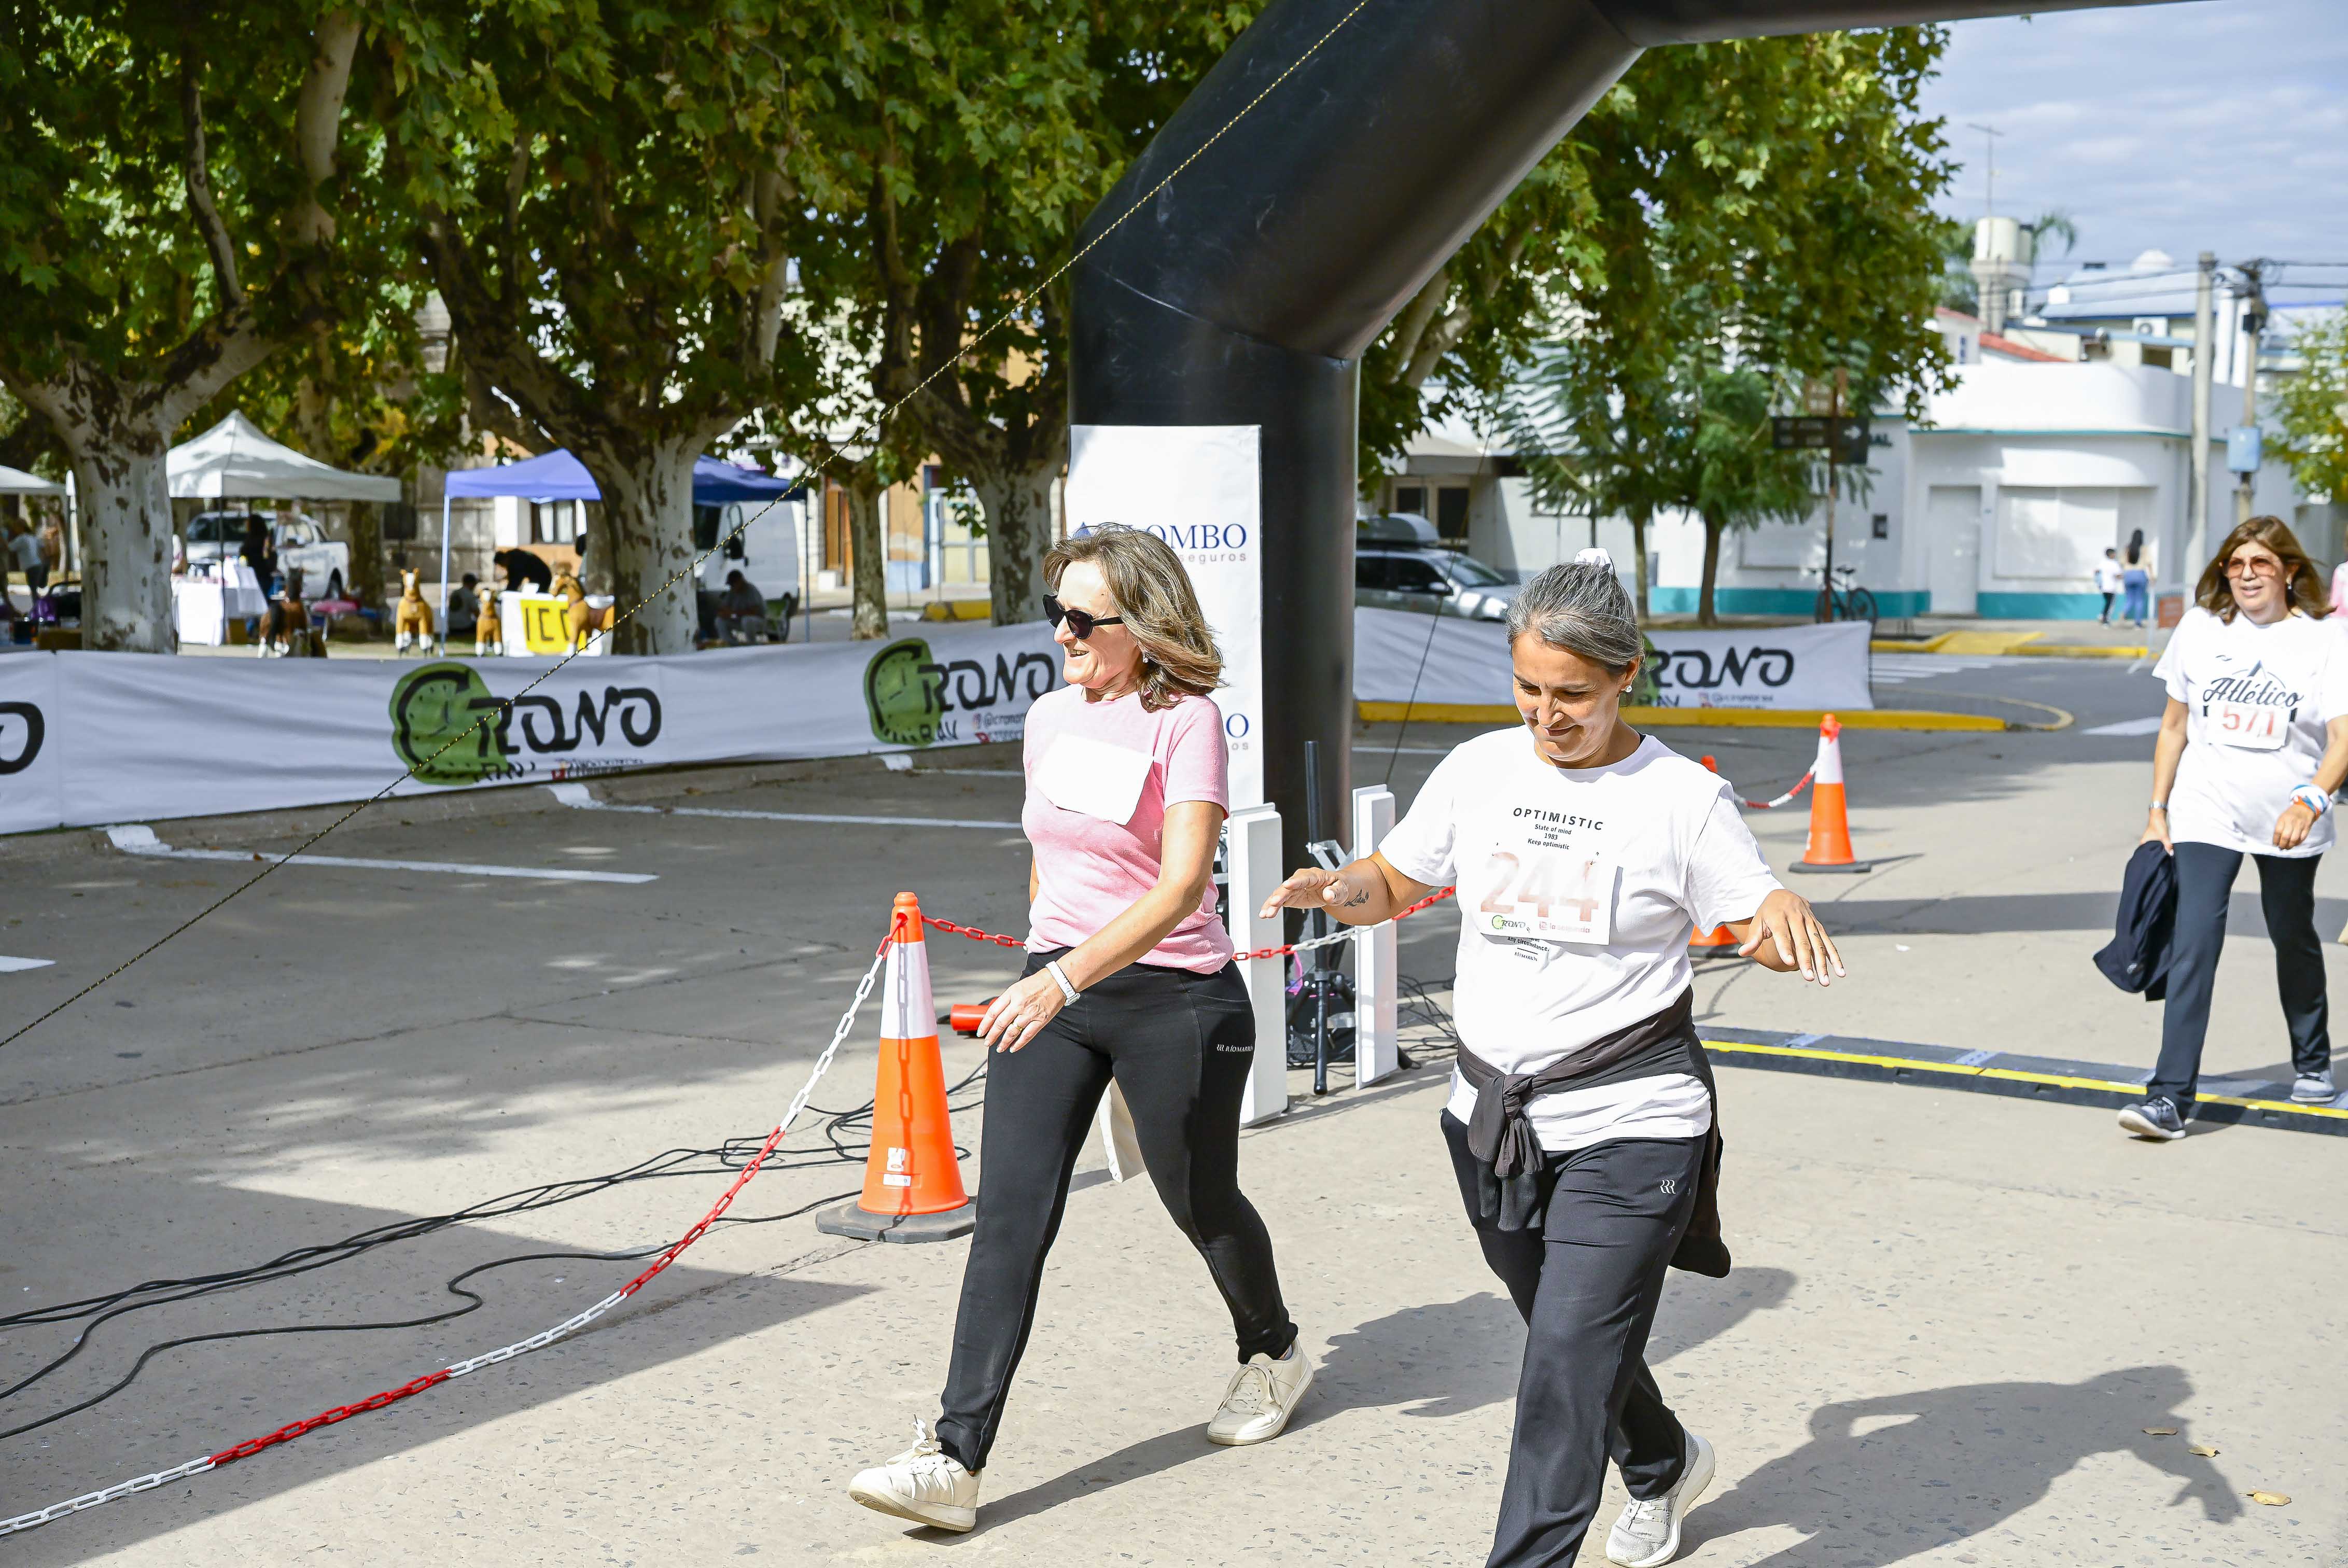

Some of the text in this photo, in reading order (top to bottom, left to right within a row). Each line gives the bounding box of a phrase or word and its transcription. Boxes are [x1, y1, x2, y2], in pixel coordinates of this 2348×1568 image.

[1650, 646, 1795, 689] RONO
[2202, 677, 2304, 707] Atlético
[2222, 705, 2275, 736] 571
[1513, 807, 1604, 831] OPTIMISTIC
[1528, 838, 1570, 850] Keep optimistic
[1480, 851, 1599, 922] 244
[1517, 938, 1550, 952] circumstance.
